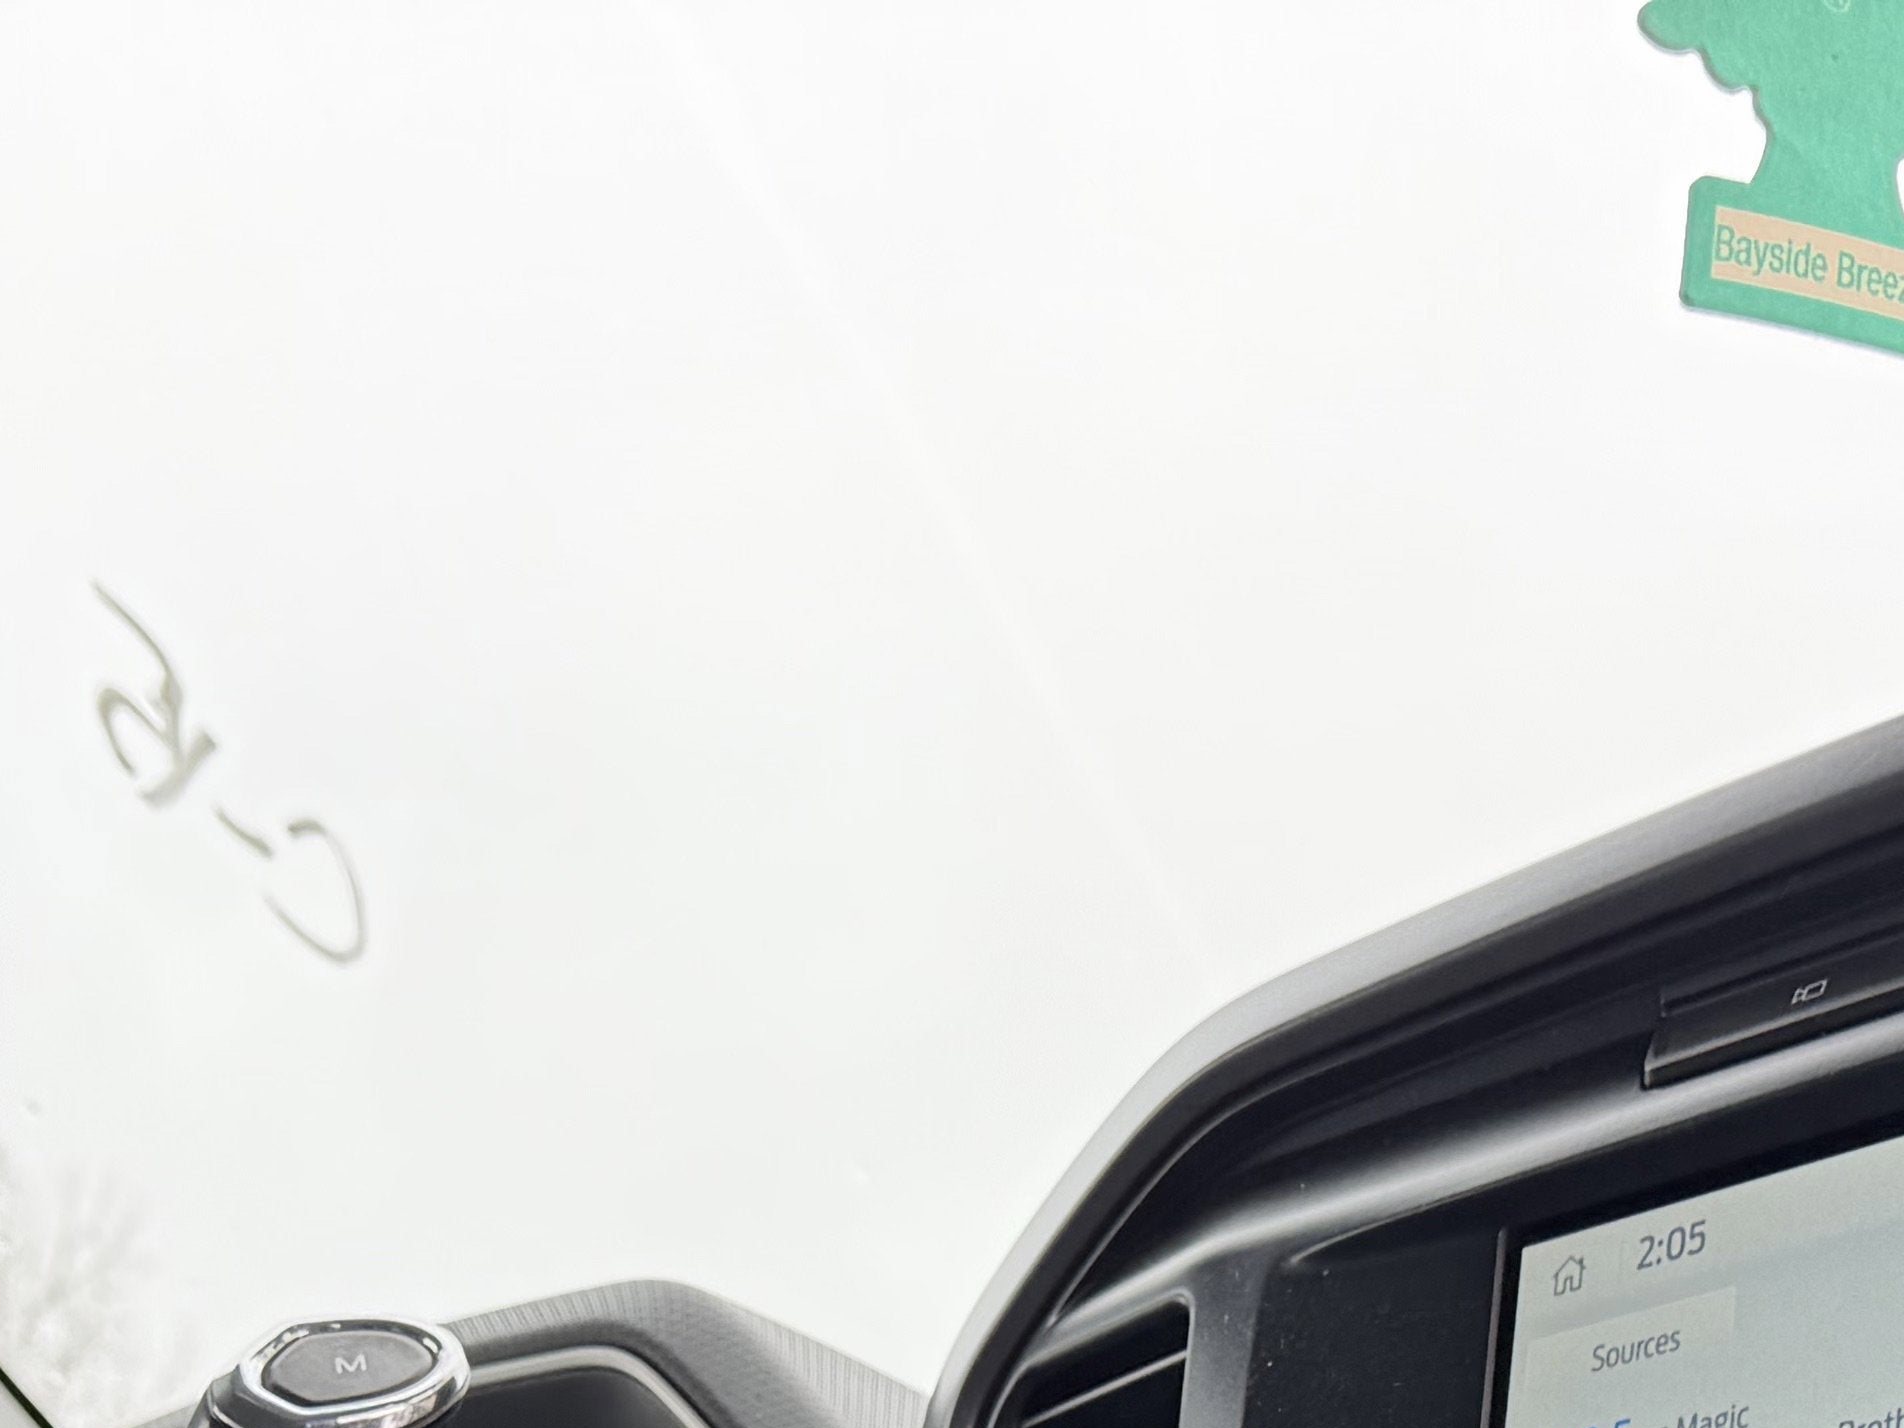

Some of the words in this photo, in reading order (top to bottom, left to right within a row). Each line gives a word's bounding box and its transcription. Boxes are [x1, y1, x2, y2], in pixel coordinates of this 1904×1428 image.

[1714, 224, 1827, 282] Bayside
[1636, 1219, 1707, 1269] 2:05
[335, 1354, 366, 1375] M
[1591, 1329, 1680, 1372] Sources
